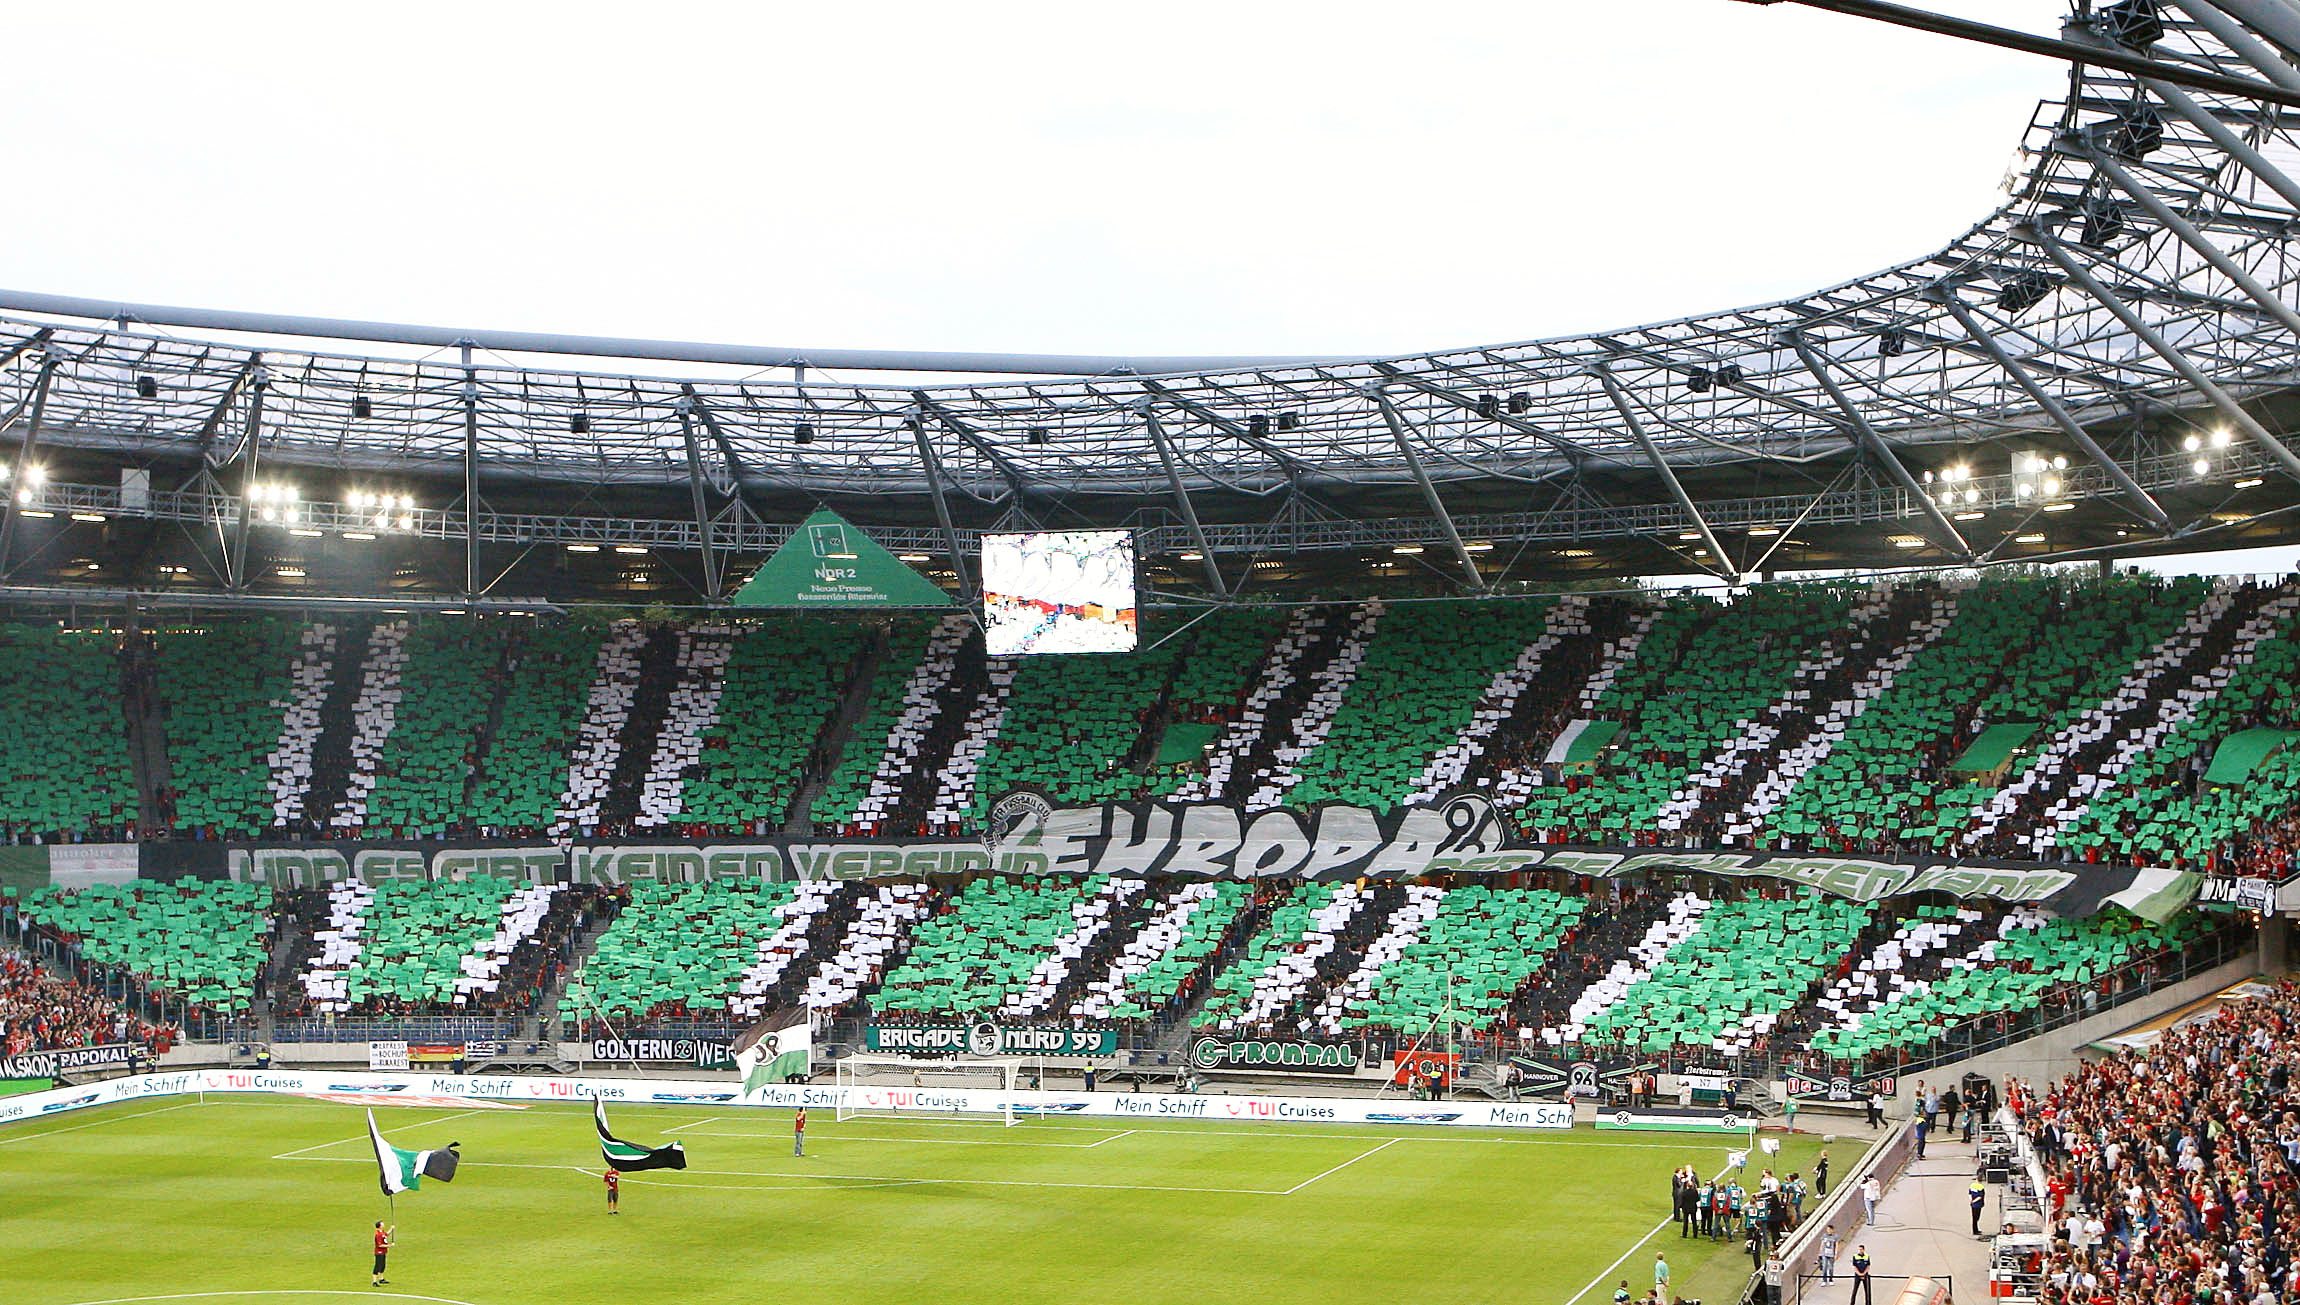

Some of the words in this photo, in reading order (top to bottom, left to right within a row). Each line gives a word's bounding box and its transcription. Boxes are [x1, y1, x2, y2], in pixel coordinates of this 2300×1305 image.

[814, 567, 845, 578] NDR
[847, 569, 857, 578] 2
[1046, 802, 1438, 880] EUROPA
[879, 1028, 966, 1048] BRIGADE
[1071, 1032, 1102, 1051] 99
[594, 1039, 673, 1059] GOLTERN
[1228, 1040, 1358, 1068] FRONTAL
[227, 1075, 252, 1088] TUI
[254, 1075, 303, 1089] Cruises
[1523, 1072, 1559, 1081] HANNOVER
[115, 1082, 138, 1097] Mein
[142, 1074, 190, 1093] Schiff
[432, 1079, 465, 1093] Mein
[470, 1080, 513, 1096] Schiff
[549, 1082, 573, 1096] TUI
[575, 1083, 625, 1098] Cruises
[762, 1088, 801, 1104] Mein
[803, 1087, 849, 1108] Schiff
[887, 1092, 913, 1105] TUI
[915, 1093, 968, 1108] Cruises
[1115, 1097, 1151, 1114] Mein
[1158, 1098, 1208, 1117] Schiff
[1248, 1102, 1276, 1116] TUI
[1278, 1103, 1335, 1118] Cruises
[1490, 1107, 1528, 1123] Mein
